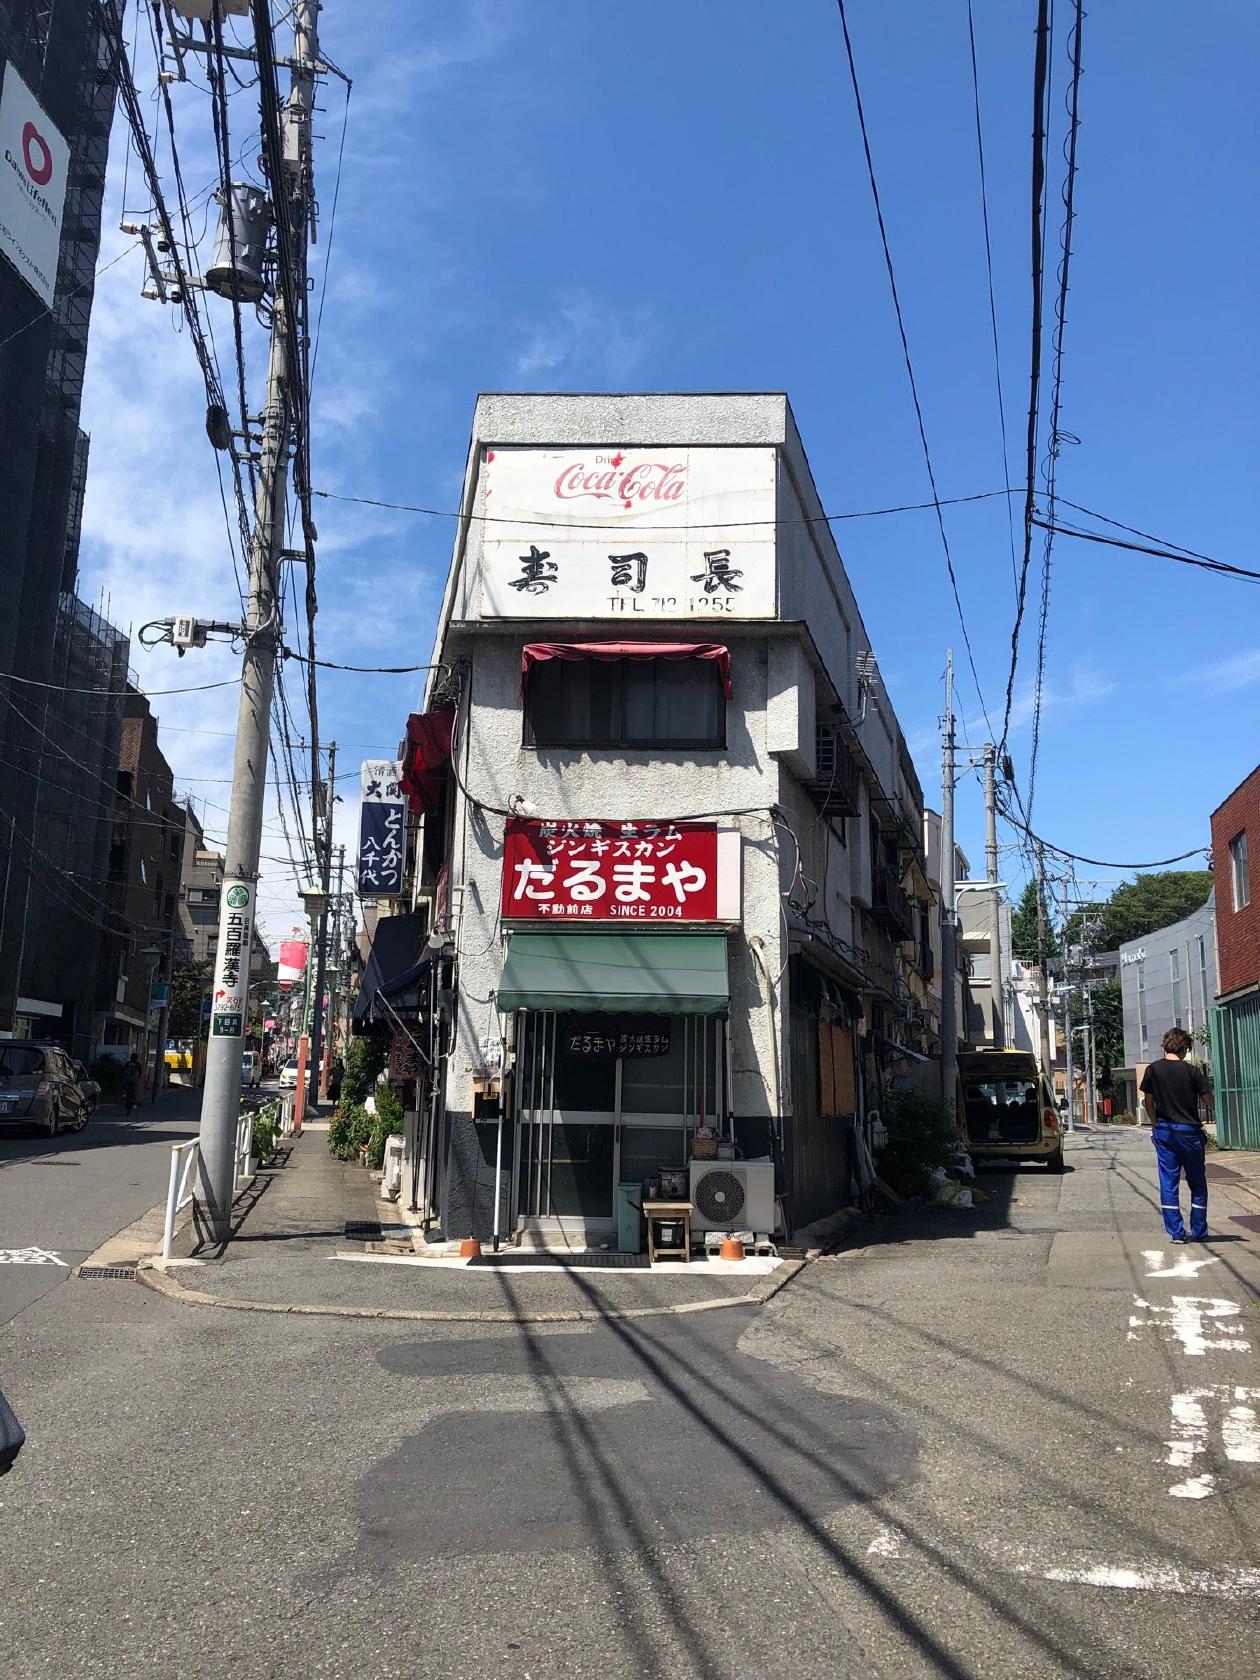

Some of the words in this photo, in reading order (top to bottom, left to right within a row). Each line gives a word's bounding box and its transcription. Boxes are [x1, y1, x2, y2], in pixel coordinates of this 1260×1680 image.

[554, 463, 687, 500] Coca-Cola
[539, 822, 603, 838] 炭火焼
[620, 822, 683, 840] 生ラム
[381, 808, 402, 886] とんかつ
[546, 839, 676, 857] ジンギスカン
[360, 836, 381, 886] 八千代
[513, 858, 707, 903] だるまや
[538, 904, 593, 915] 不動前店
[610, 904, 646, 917] SINCE
[650, 905, 683, 917] 2004
[222, 912, 243, 988] 五百羅漢寺
[570, 1035, 616, 1053] だるまや
[620, 1044, 669, 1054] ジンギスカン
